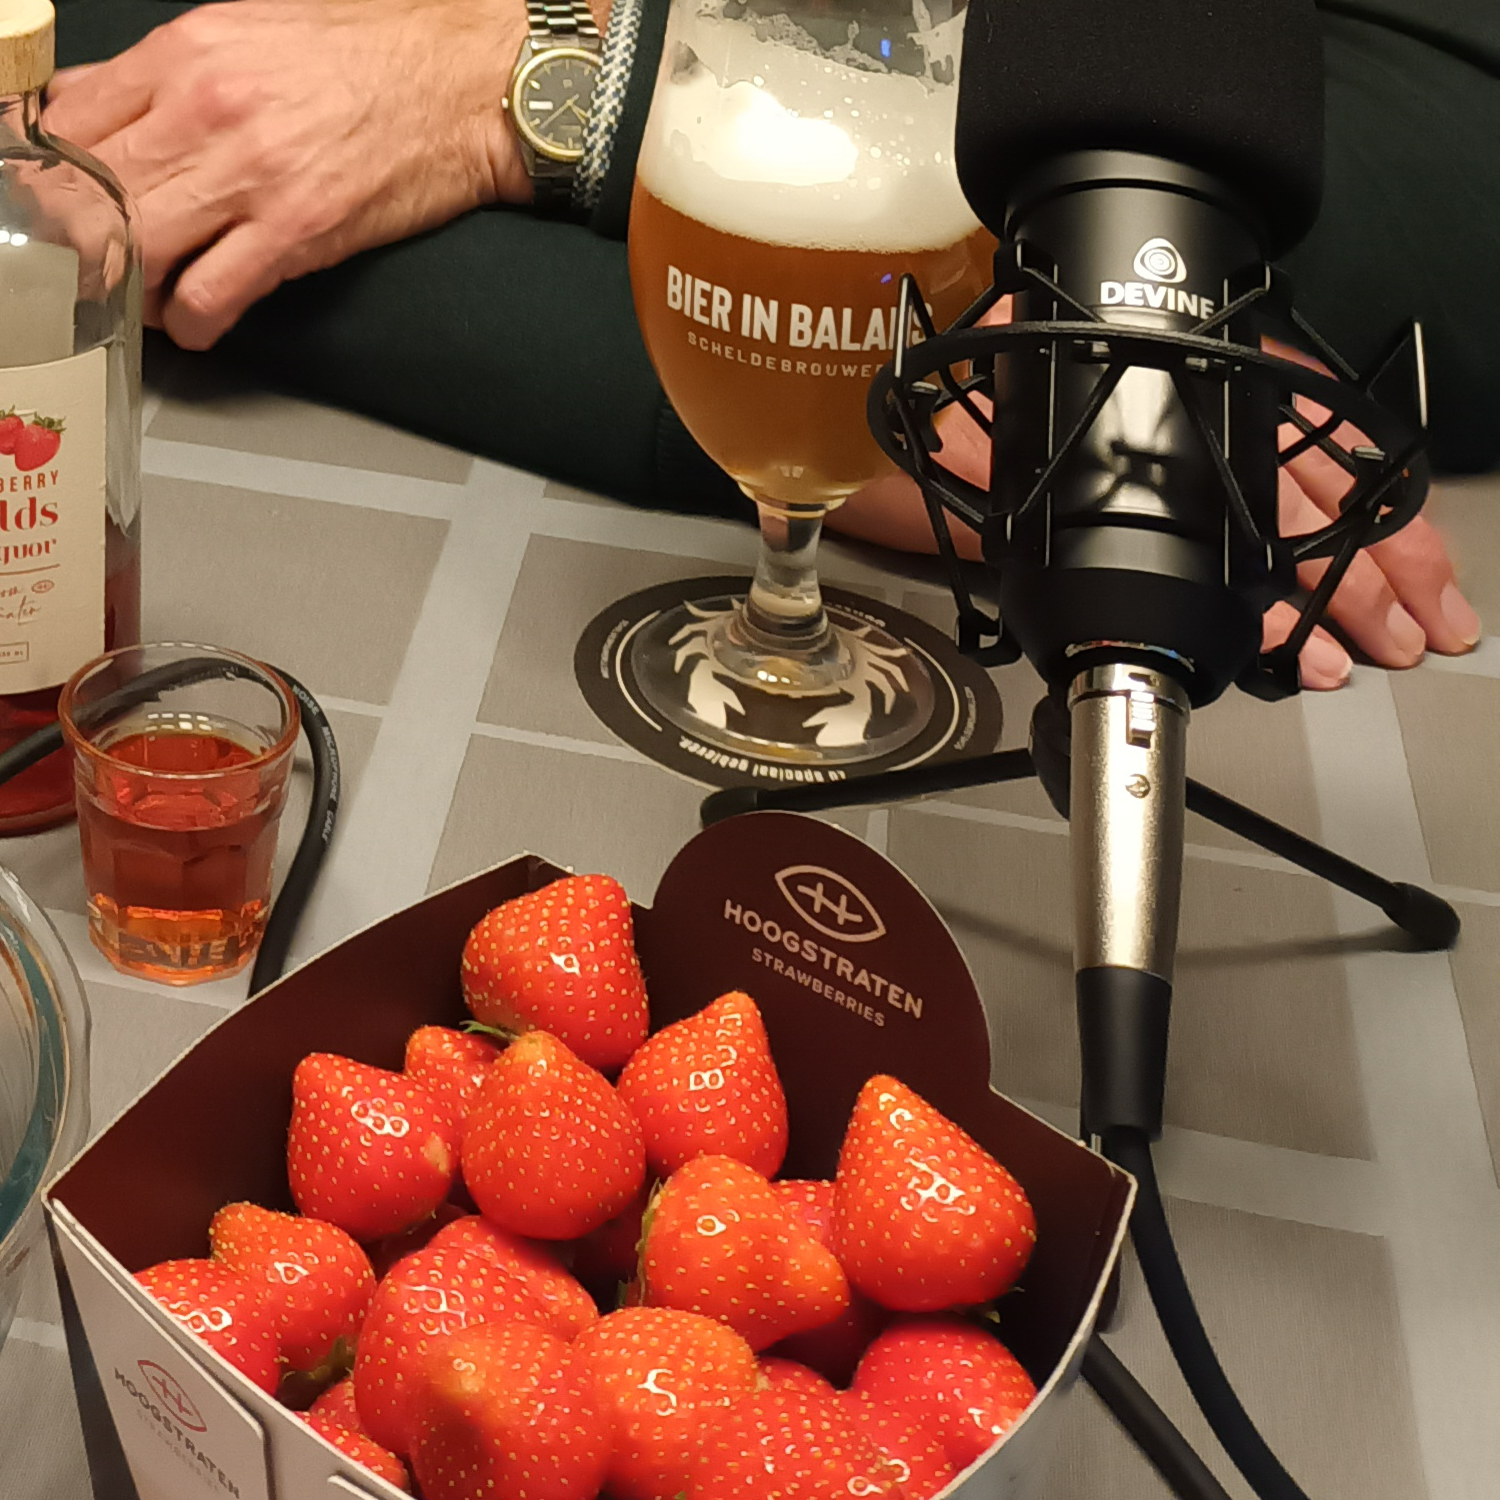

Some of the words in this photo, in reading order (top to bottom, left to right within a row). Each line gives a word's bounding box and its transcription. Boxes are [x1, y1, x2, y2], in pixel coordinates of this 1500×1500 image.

[667, 264, 733, 333] BIER
[740, 294, 780, 345] IN
[1100, 281, 1215, 320] DEVINE
[723, 898, 923, 1019] HOOGSTRATEN
[751, 947, 885, 1027] STRAWBERRIES
[114, 1367, 240, 1499] HOOGSTRATEN
